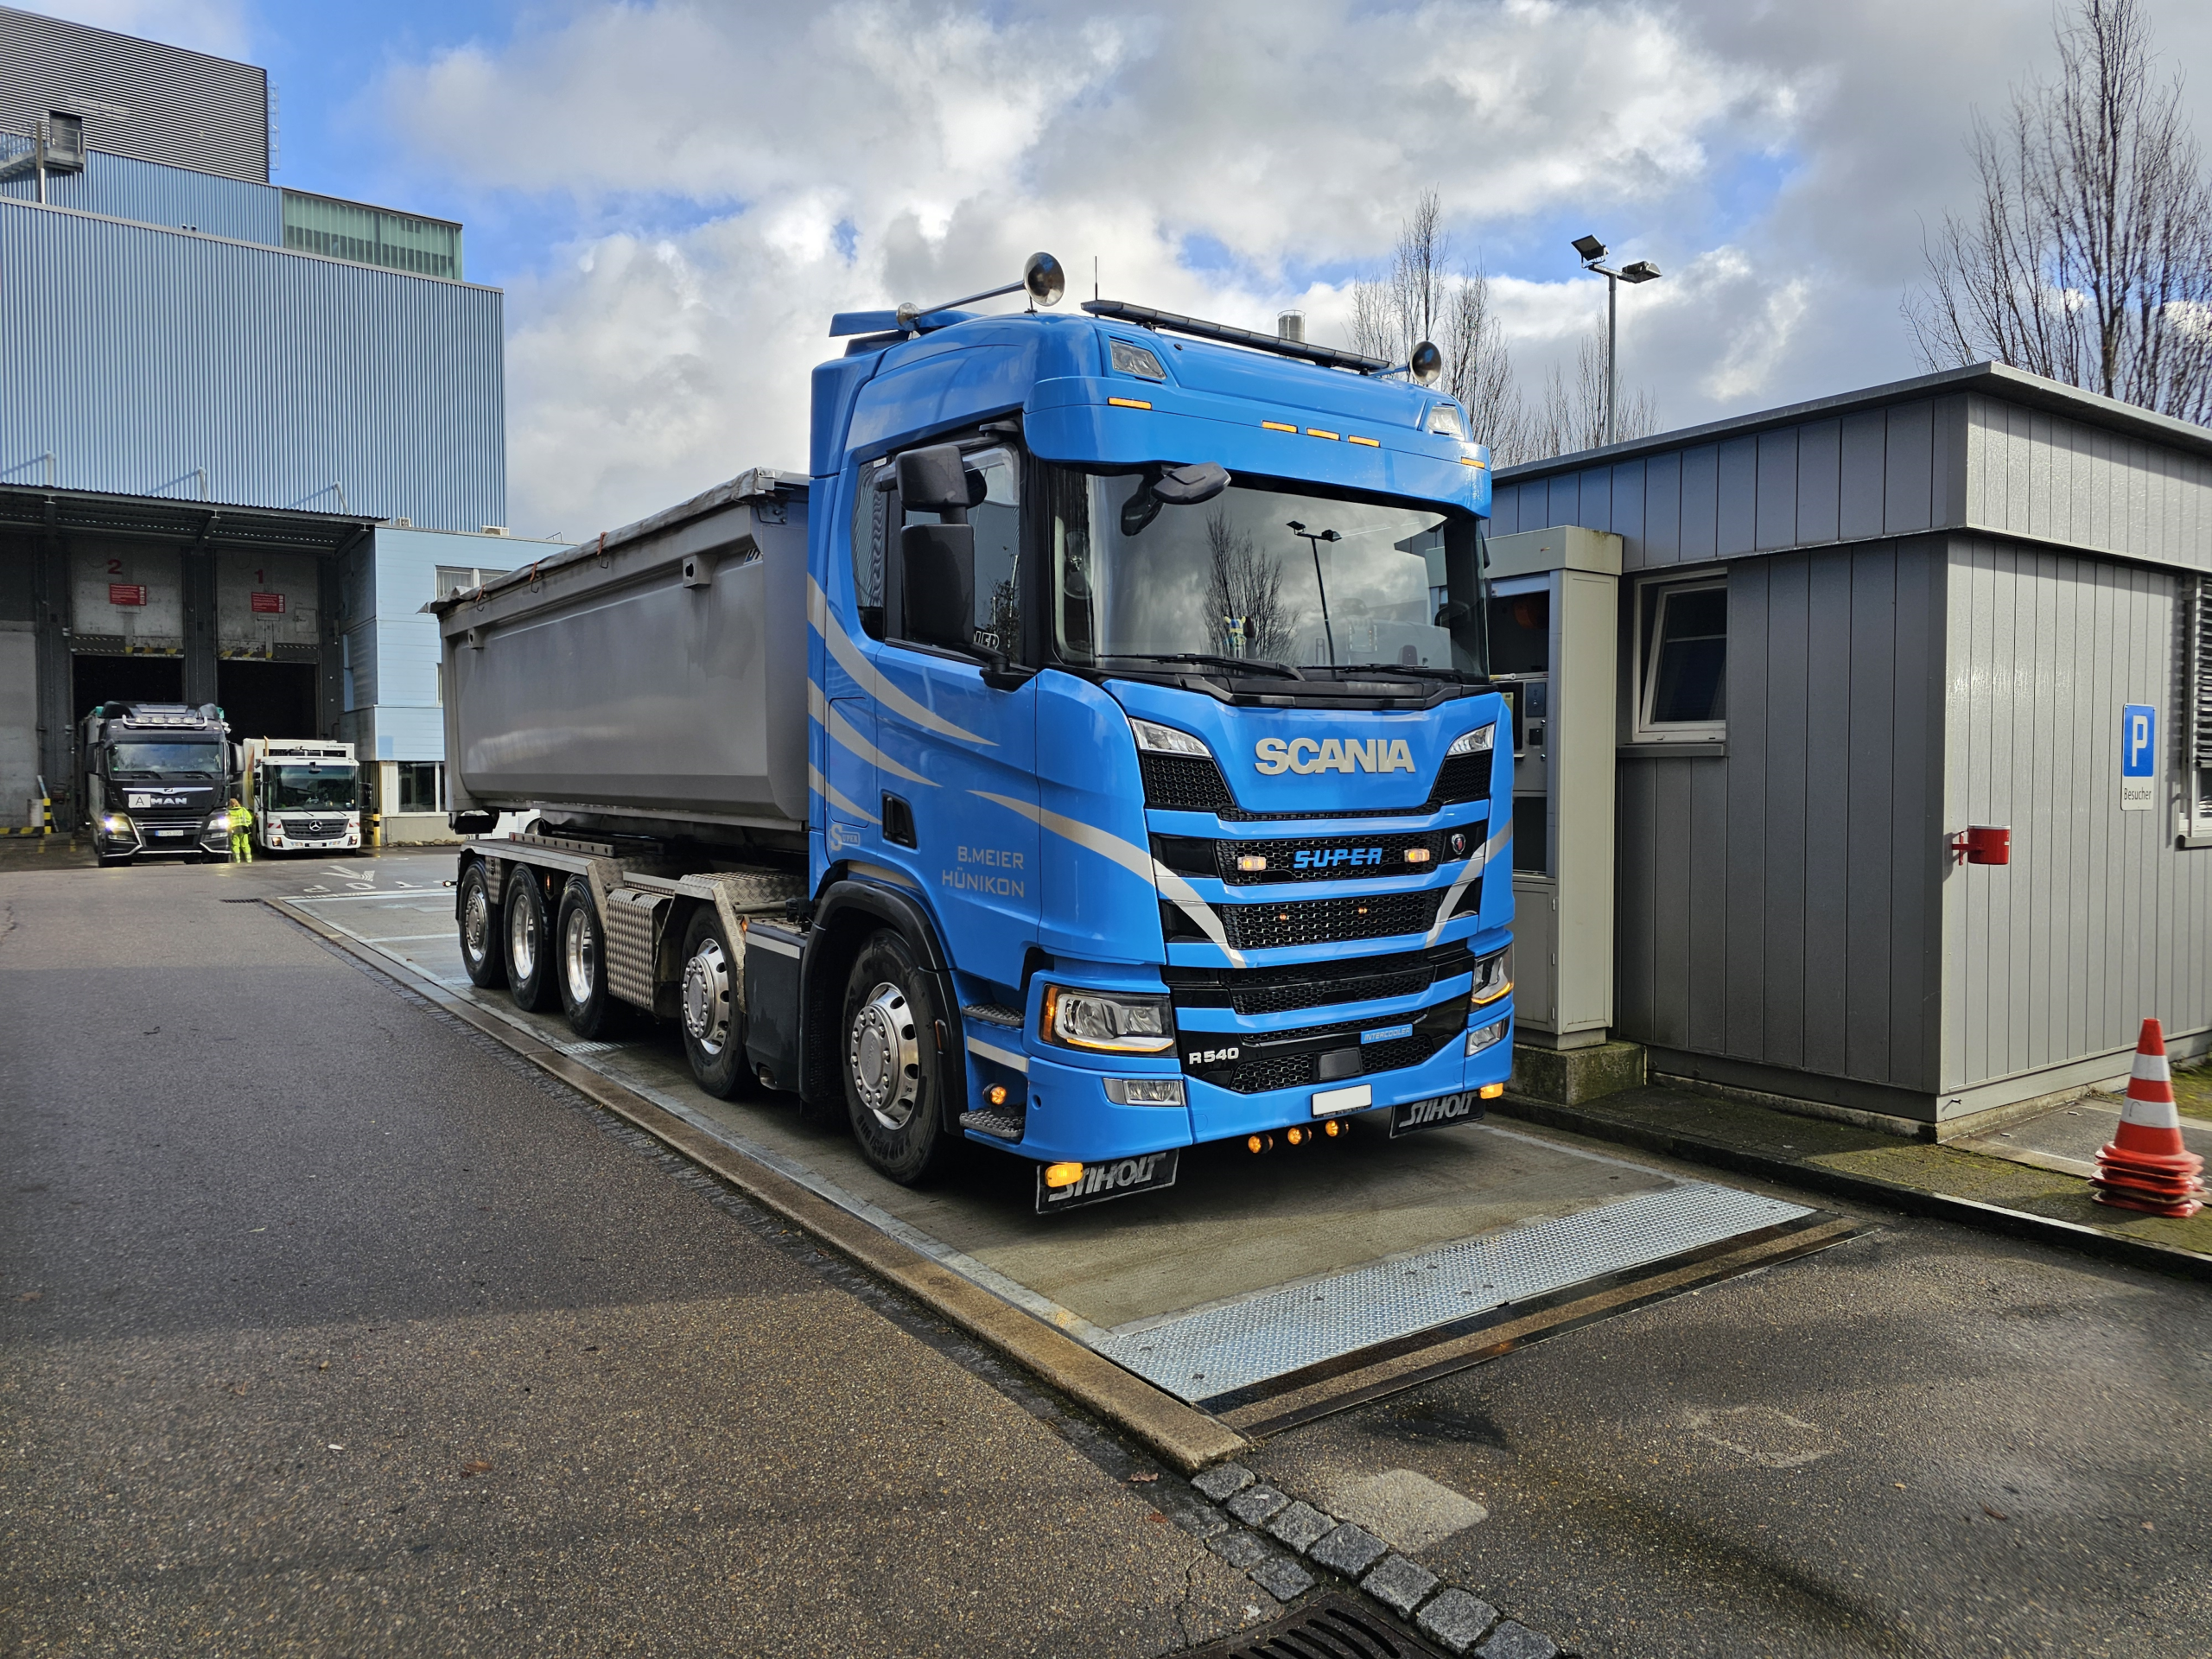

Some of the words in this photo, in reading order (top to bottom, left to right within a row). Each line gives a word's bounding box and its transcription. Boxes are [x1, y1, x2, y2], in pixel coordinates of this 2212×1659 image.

[107, 558, 123, 575] 2
[253, 569, 264, 584] 1
[2131, 715, 2149, 767] P
[1255, 737, 1416, 775] SCANIA
[135, 796, 145, 806] A
[2124, 786, 2152, 800] Besucher
[957, 846, 1024, 870] B.MEIER
[1294, 848, 1382, 869] SUPER
[942, 867, 1024, 898] HÜNIKON
[1363, 1027, 1411, 1042] INTERCOOLER
[1188, 1052, 1202, 1065] R
[1203, 1047, 1240, 1063] 540
